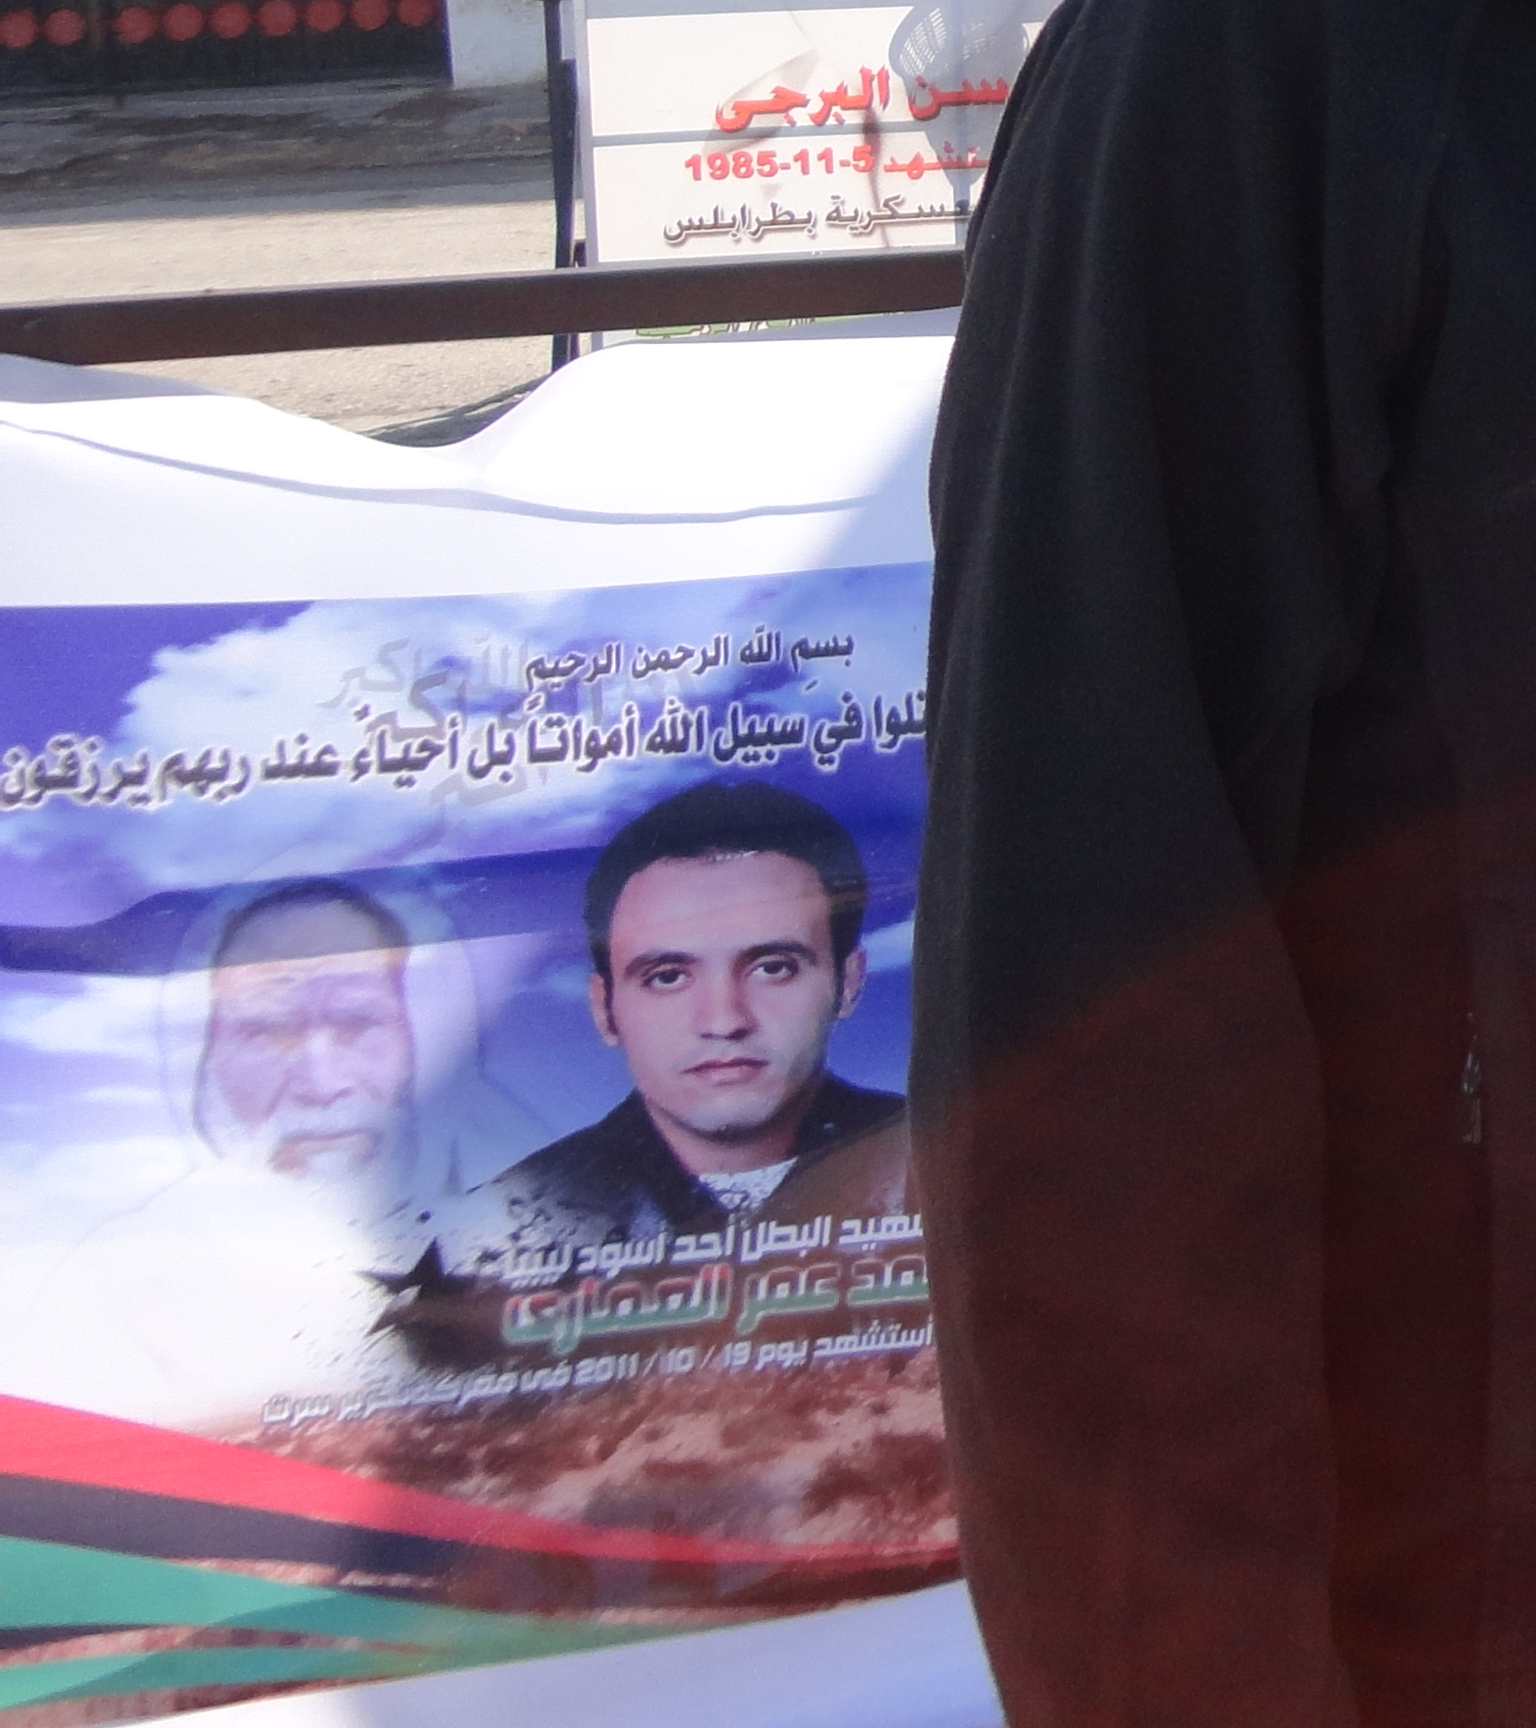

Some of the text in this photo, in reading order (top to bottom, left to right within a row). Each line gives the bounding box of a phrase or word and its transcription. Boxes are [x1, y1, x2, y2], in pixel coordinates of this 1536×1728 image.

[663, 196, 817, 245] بطرابلس
[525, 642, 620, 690] الرحيم
[630, 634, 729, 681] الرحمن
[740, 625, 783, 665] الله
[645, 698, 706, 755] الله
[714, 702, 805, 767] سبيل
[813, 690, 863, 766] في
[1, 734, 150, 808] يرزقون
[156, 746, 251, 804] ربهم
[260, 732, 340, 782] عند
[467, 721, 517, 784] بل
[740, 1215, 832, 1262] البطل
[574, 1352, 641, 1385] 2011
[755, 1340, 809, 1370] يوم
